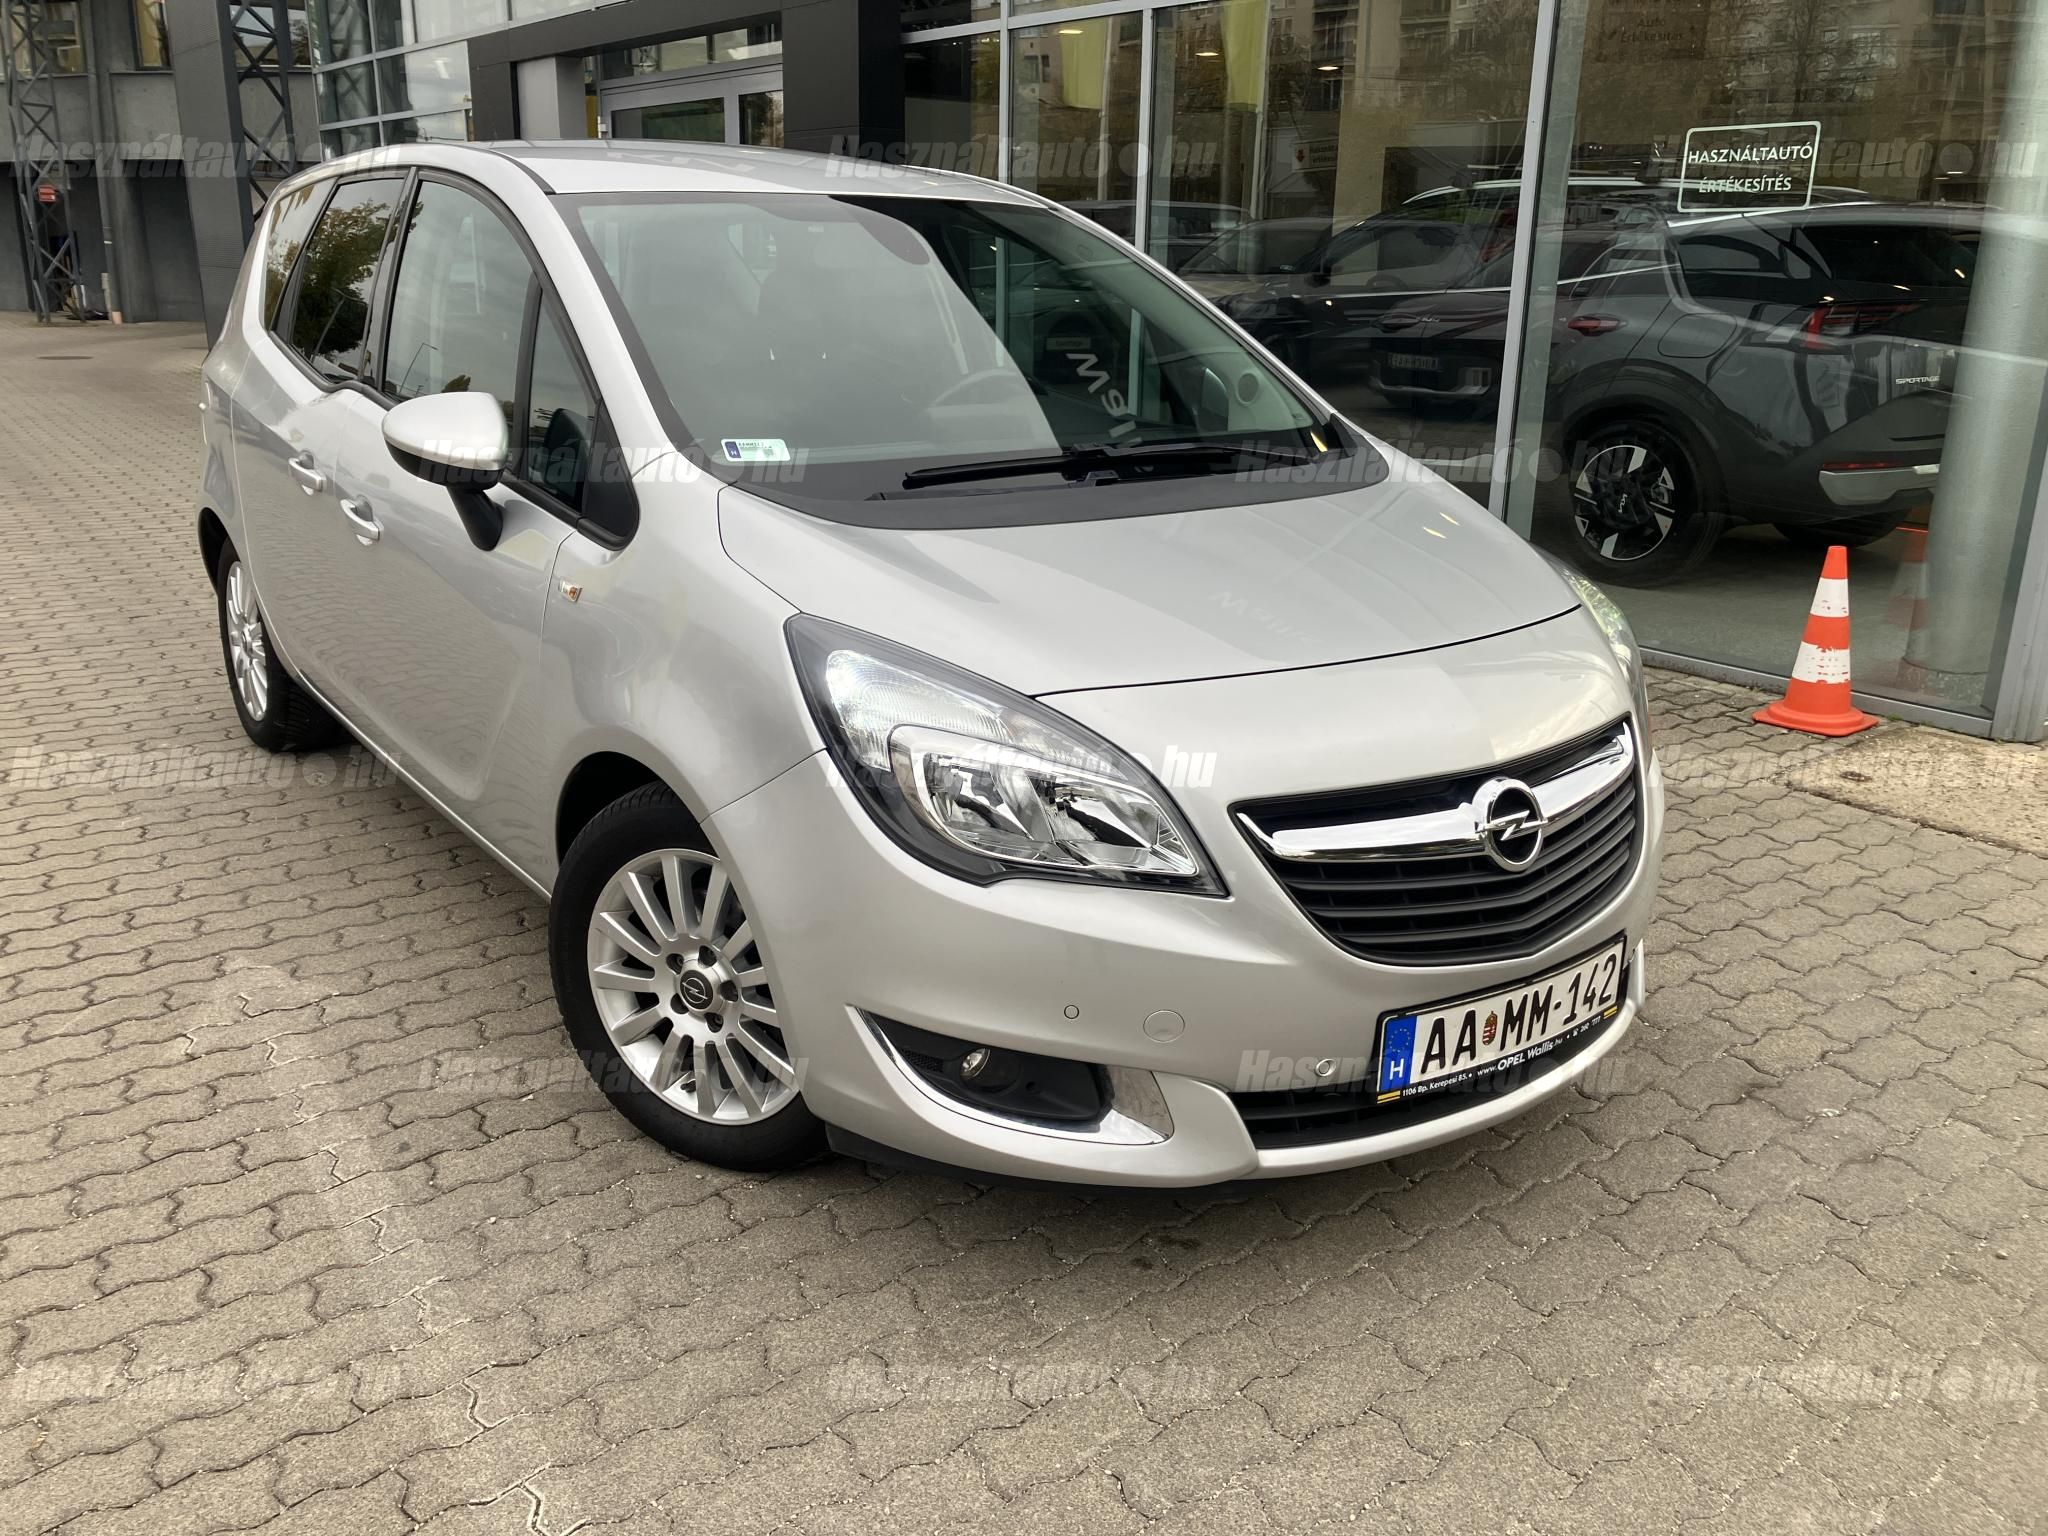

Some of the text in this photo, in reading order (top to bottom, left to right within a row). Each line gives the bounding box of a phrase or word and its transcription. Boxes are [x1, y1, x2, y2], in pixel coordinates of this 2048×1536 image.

[1688, 141, 1813, 164] HASZNÁLTAUTÓ
[1699, 175, 1792, 194] ÉRTÉKESÍTÉS
[1895, 375, 1941, 385] SPORTAGE
[1421, 953, 1617, 1074] AA MM-142
[1389, 1057, 1405, 1081] H
[1429, 1075, 1458, 1091] Kerepesi
